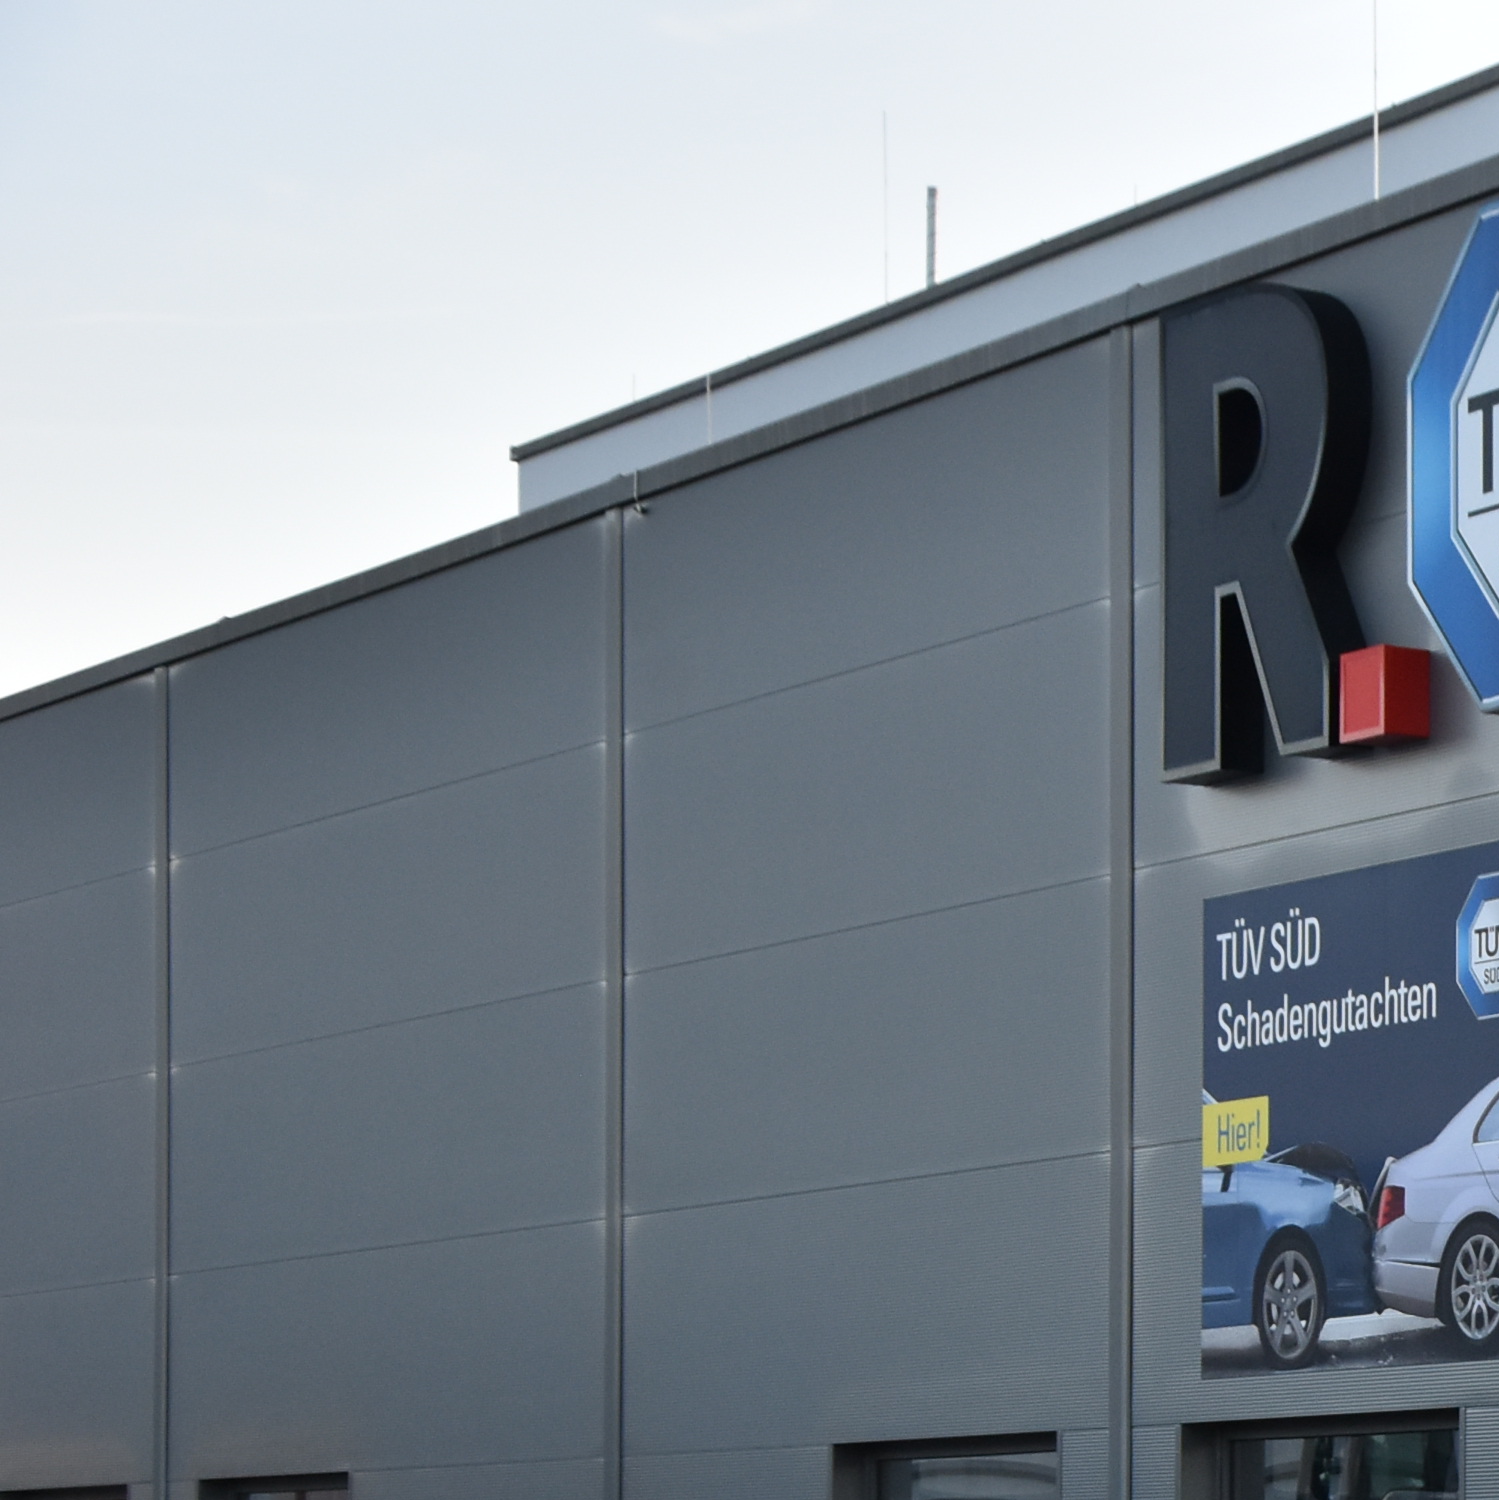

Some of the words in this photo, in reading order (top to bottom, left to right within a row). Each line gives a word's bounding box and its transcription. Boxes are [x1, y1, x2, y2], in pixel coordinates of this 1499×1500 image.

[1216, 917, 1265, 981] TÜV
[1270, 908, 1321, 971] SÜD
[1217, 976, 1437, 1052] Schadengutachten
[1217, 1109, 1262, 1154] Hier!
